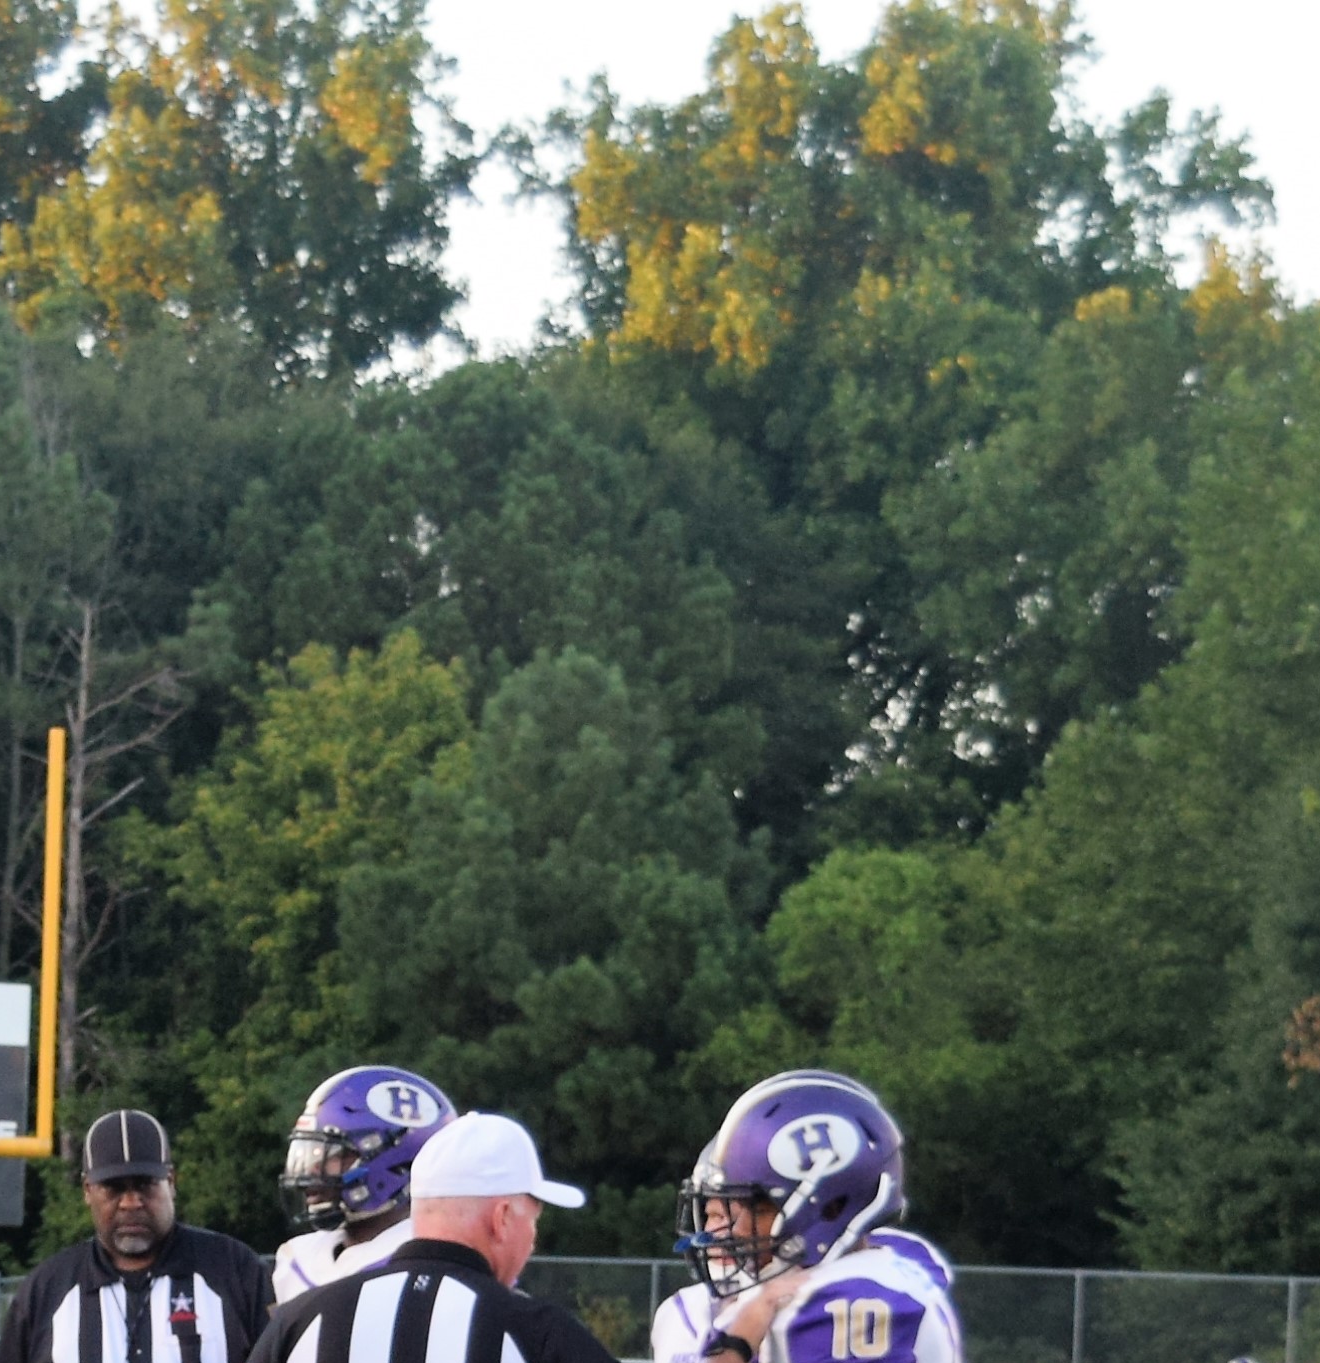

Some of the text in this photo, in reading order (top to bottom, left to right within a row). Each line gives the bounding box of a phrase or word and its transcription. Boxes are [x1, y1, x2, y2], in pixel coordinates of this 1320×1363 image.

[386, 1086, 421, 1121] H
[789, 1121, 839, 1172] H
[824, 1298, 891, 1361] 10
